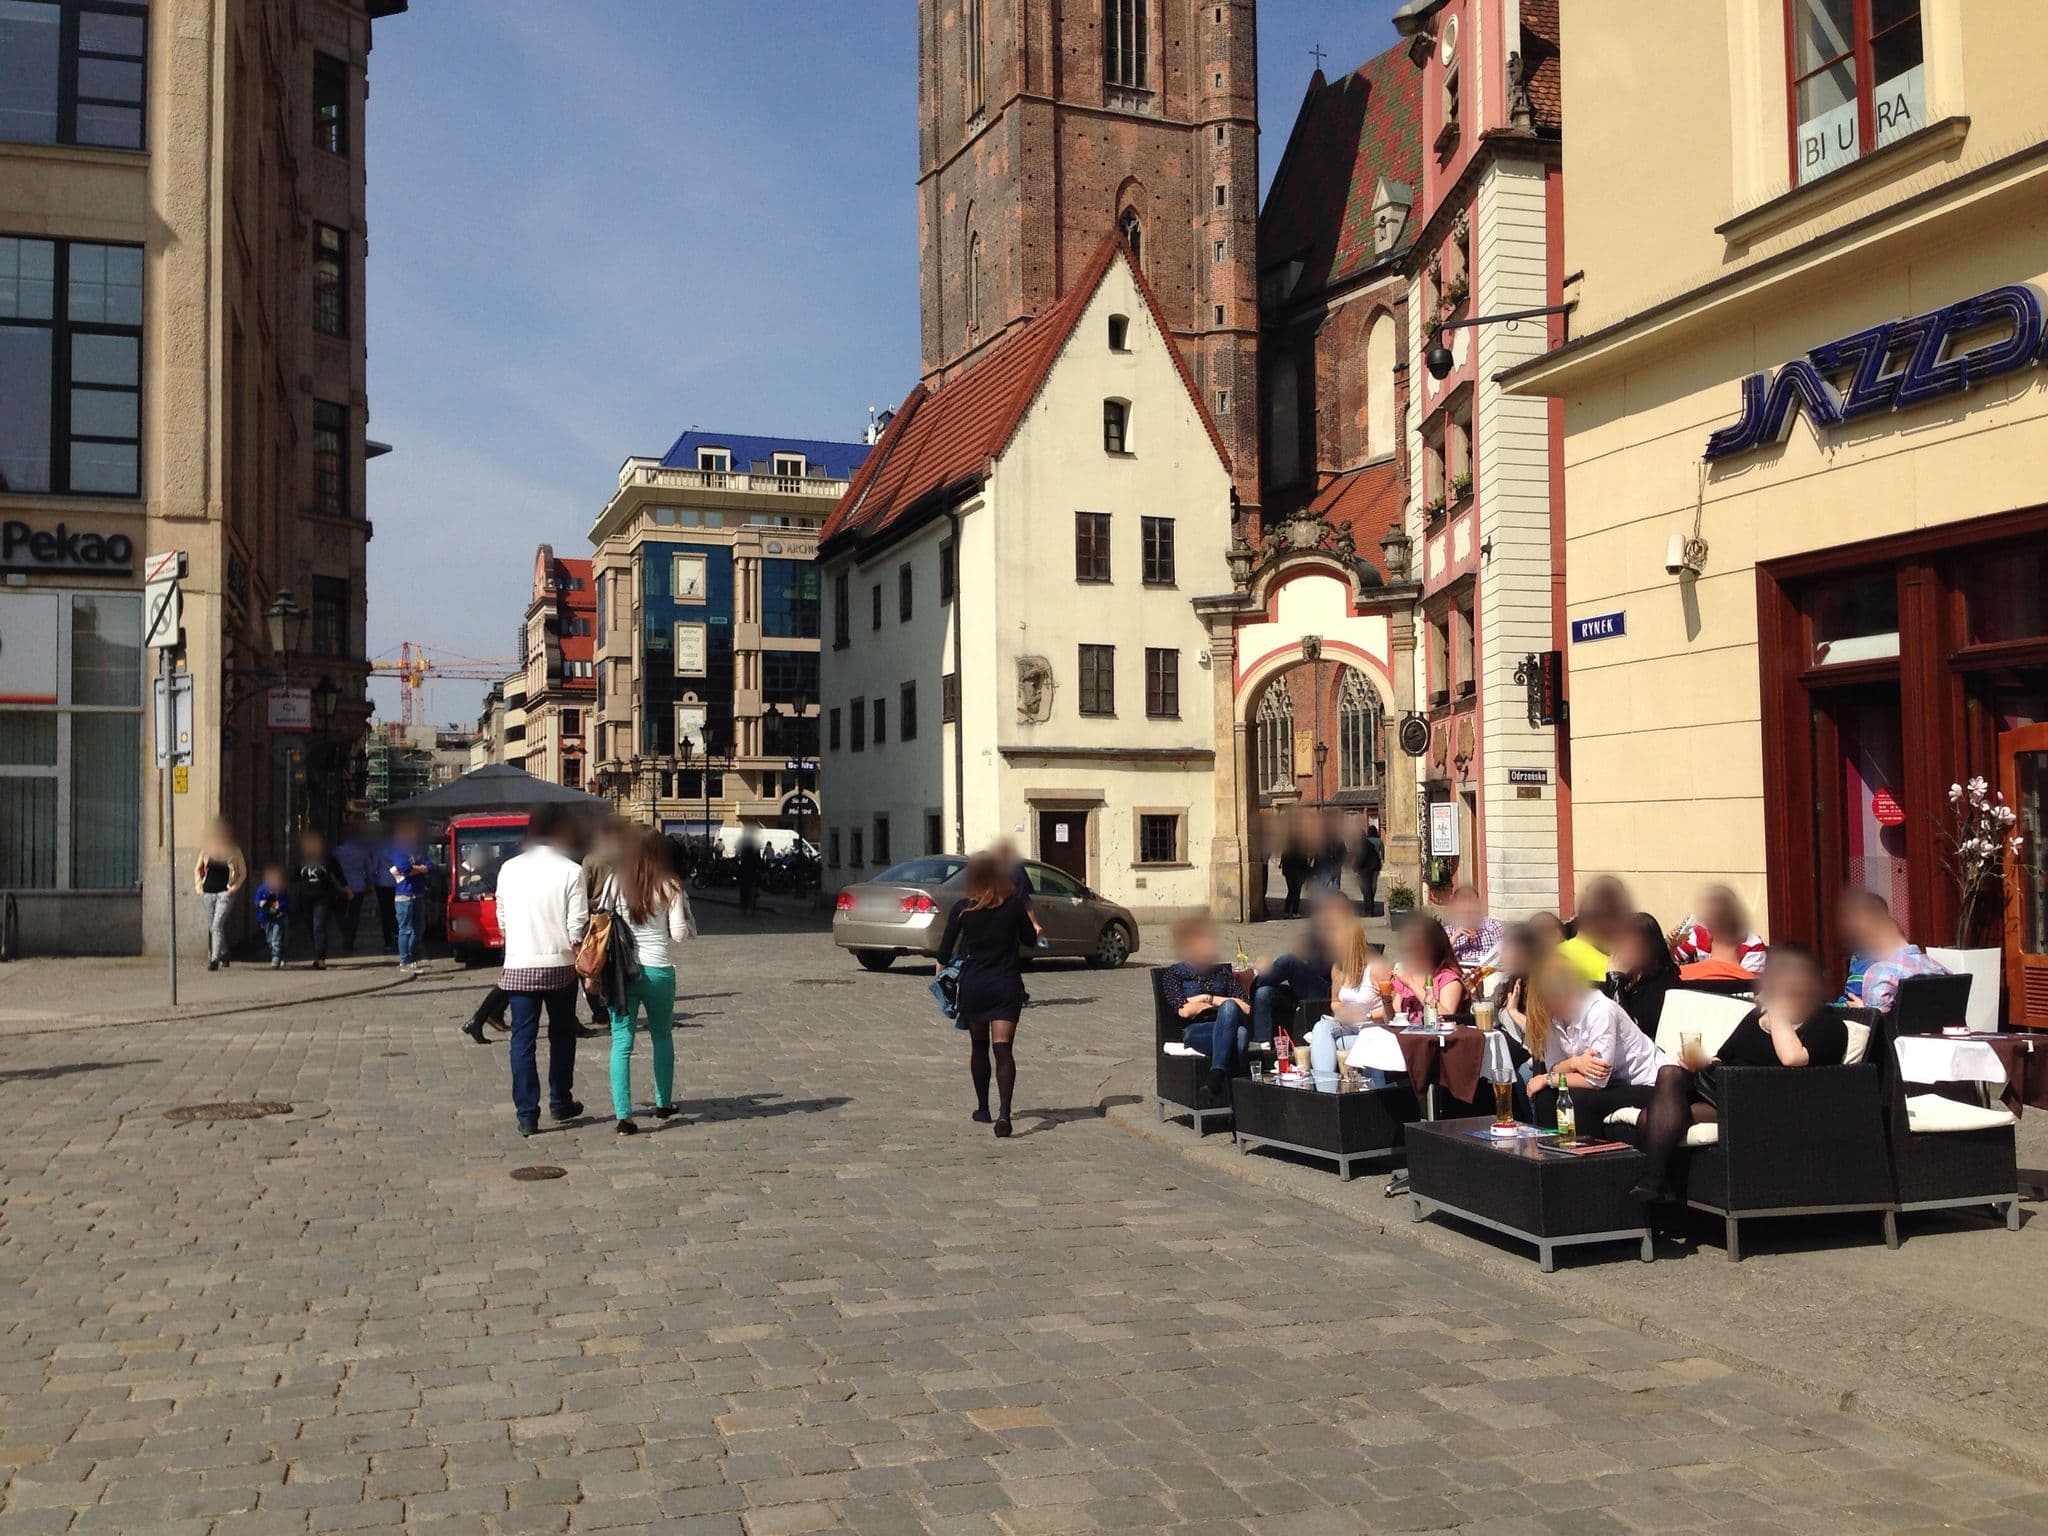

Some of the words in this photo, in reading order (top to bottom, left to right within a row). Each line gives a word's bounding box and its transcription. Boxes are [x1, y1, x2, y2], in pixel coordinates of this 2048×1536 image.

[1702, 284, 2048, 464] JAZZD
[2, 521, 133, 563] Pekao
[1582, 618, 1614, 638] RYNEK
[787, 761, 815, 769] Belitz
